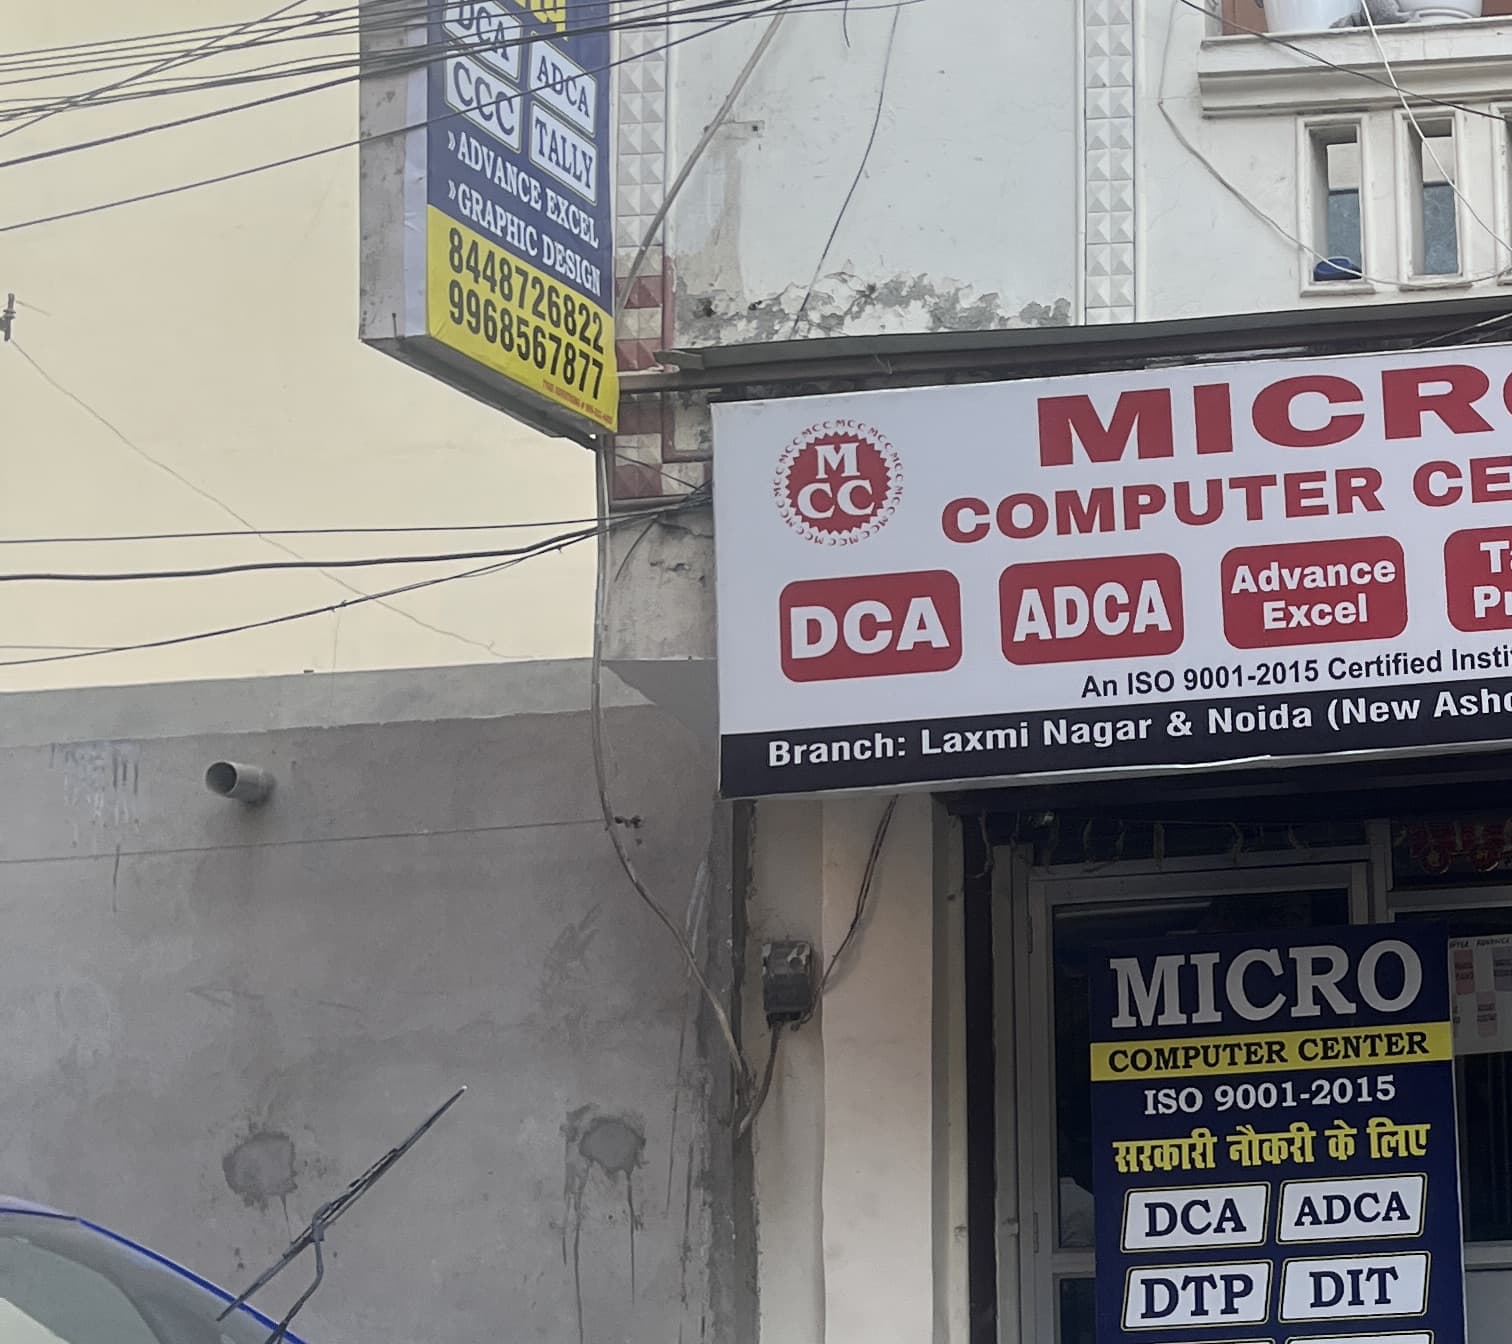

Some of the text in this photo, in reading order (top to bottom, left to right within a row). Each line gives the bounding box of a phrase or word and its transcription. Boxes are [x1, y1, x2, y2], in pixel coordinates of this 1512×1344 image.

[453, 60, 515, 136] CCC
[536, 55, 590, 119] ADCA
[535, 116, 594, 191] TALLY
[457, 133, 599, 249] ADVANCE EXCEL
[457, 183, 601, 297] GRAPHIC DESIGN
[448, 227, 604, 354] 8448726822
[448, 279, 604, 400] 9968567877
[941, 467, 1386, 544] COMPUTER
[1231, 555, 1397, 594] Advance
[789, 596, 950, 660] DCA
[1011, 580, 1173, 643] ADCA
[1262, 593, 1369, 633] Excel
[1081, 673, 1118, 699] An
[1126, 668, 1175, 697] ISO
[1183, 659, 1320, 692] 9001-2015
[1326, 649, 1443, 683] Certified
[767, 729, 907, 768] Branch:
[921, 720, 1029, 757] Laxmi
[1042, 713, 1153, 750] Nagar
[1165, 711, 1194, 739] &
[1207, 701, 1313, 735] Noida
[1327, 695, 1420, 733] (New
[1109, 939, 1423, 1029] MICRO
[1107, 1030, 1430, 1073] COMPUTER CENTER
[1143, 1074, 1397, 1116] ISO 9001-2015
[1112, 1116, 1432, 1174] सरकारी नौकरी के लिए
[1144, 1197, 1247, 1238] DCA
[1294, 1190, 1411, 1227] ADCA
[1140, 1273, 1254, 1319] DTP
[1308, 1266, 1399, 1309] DIT
